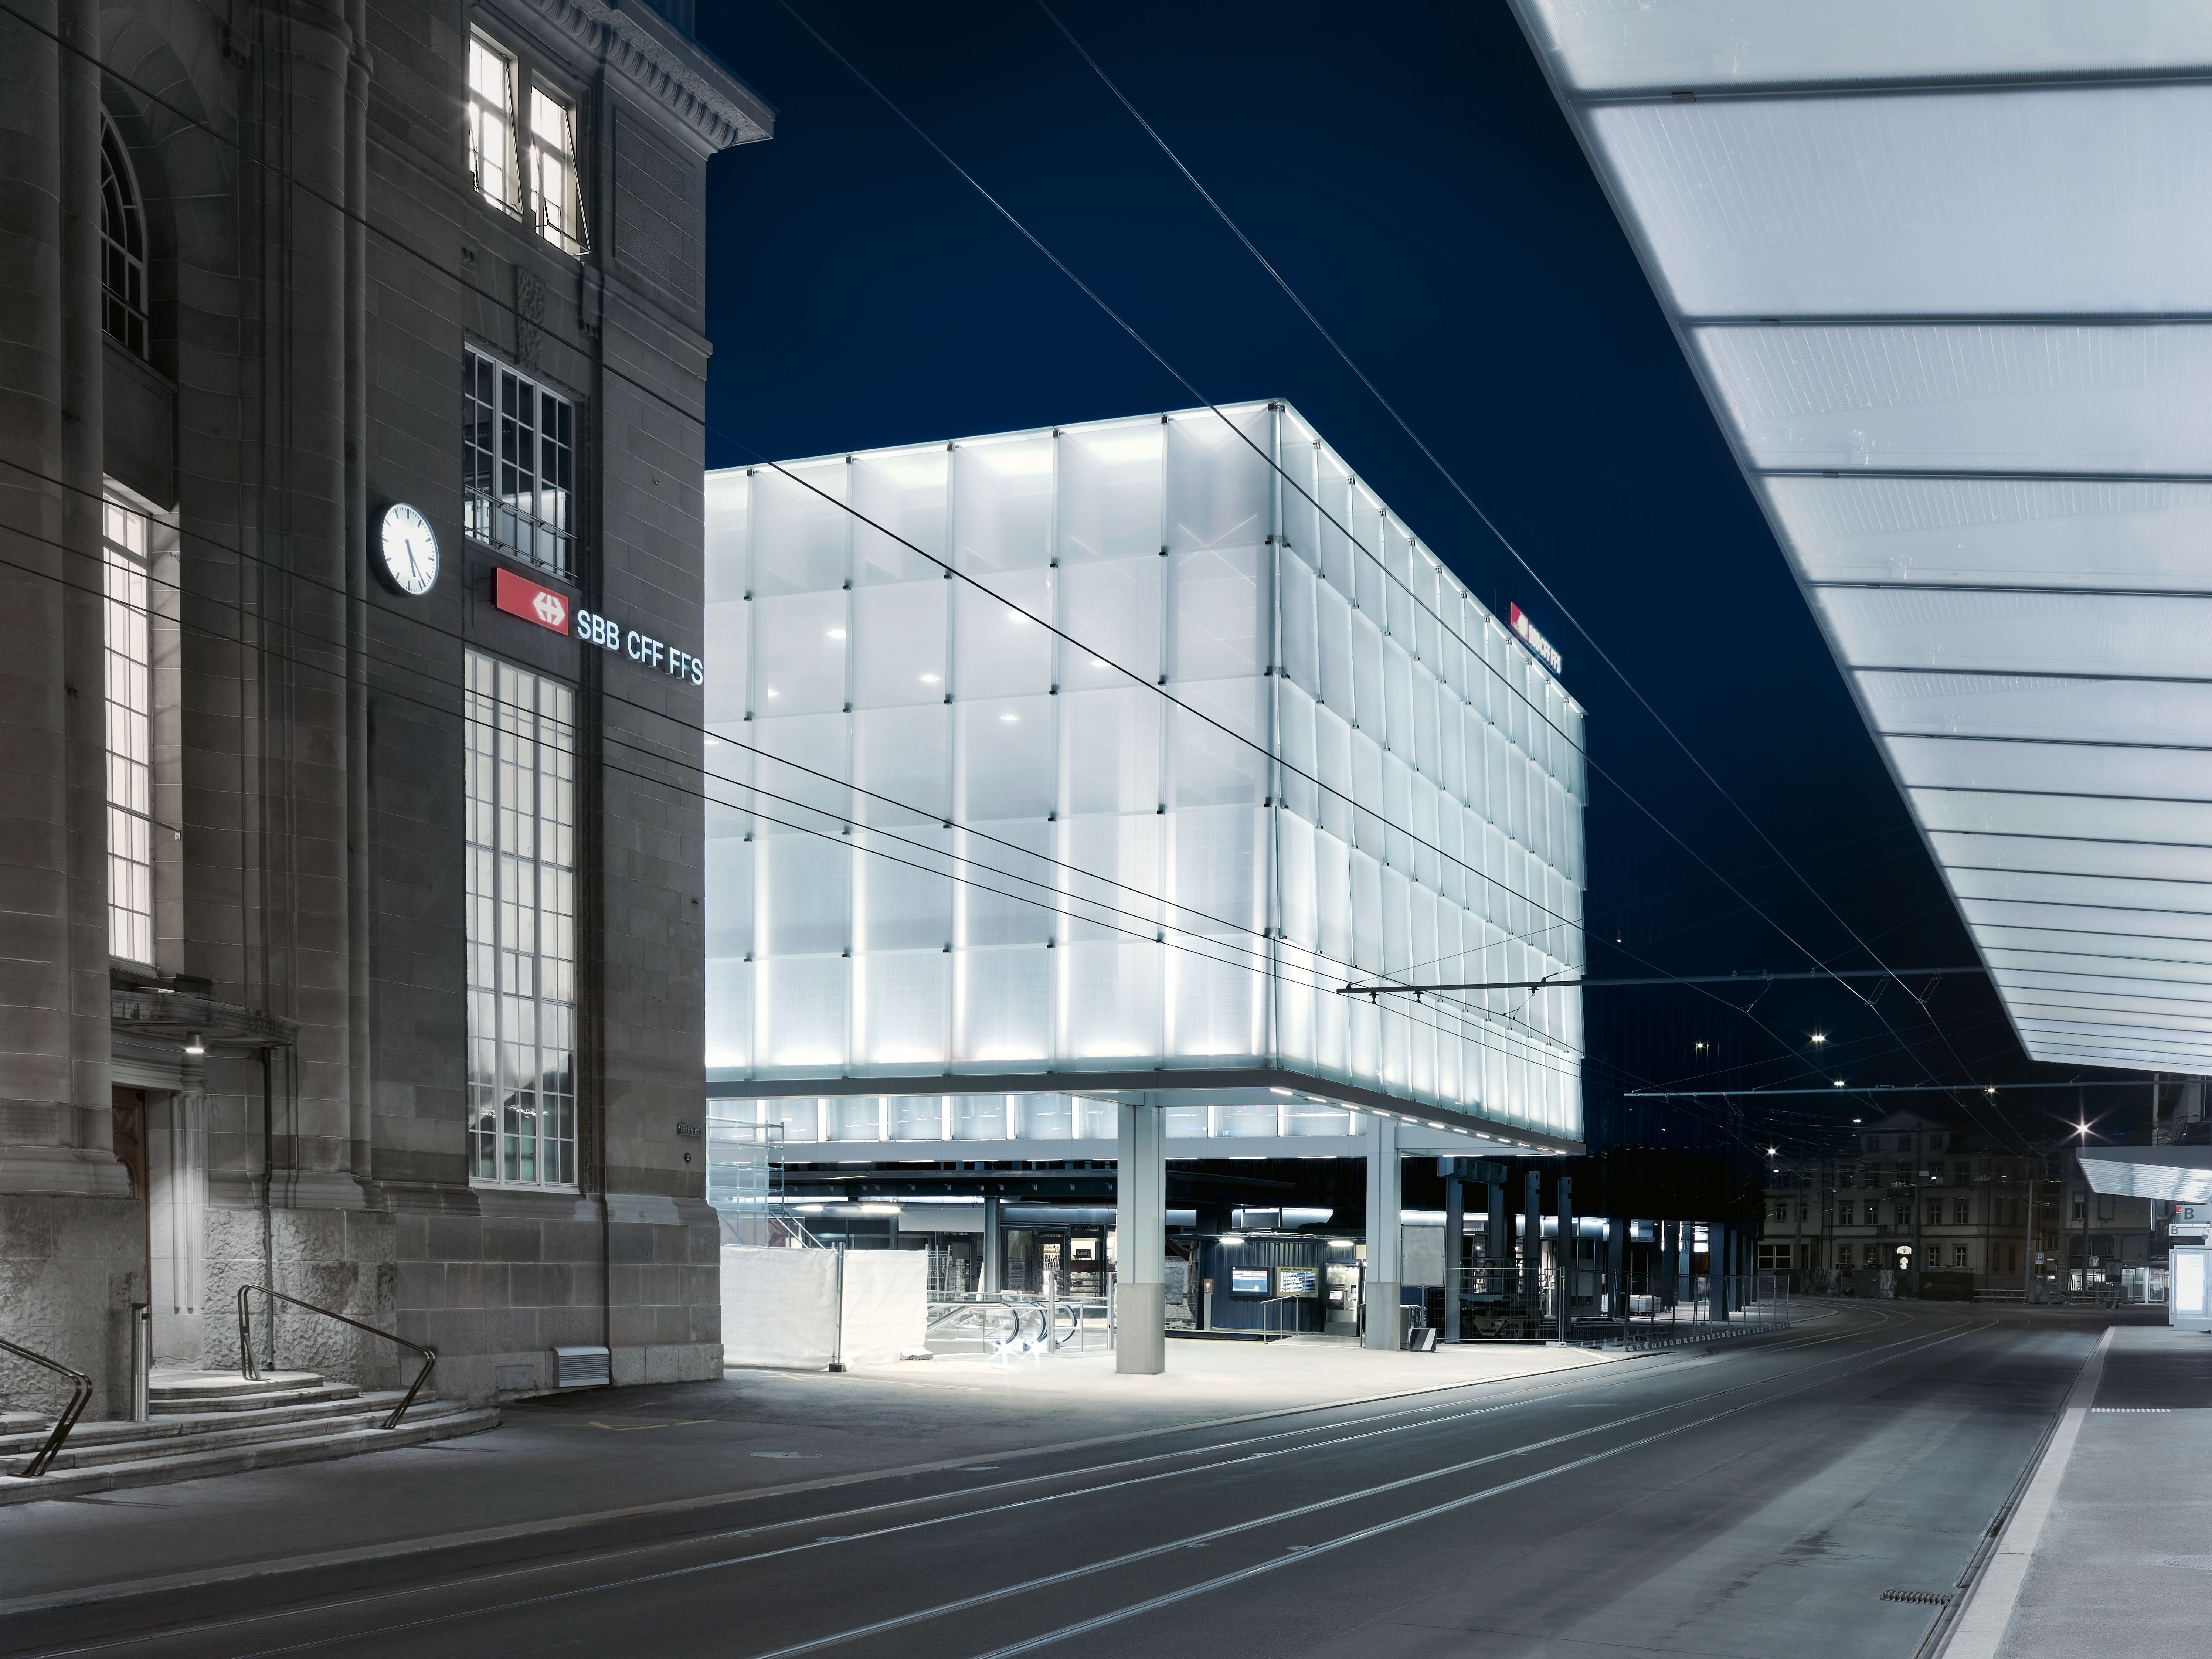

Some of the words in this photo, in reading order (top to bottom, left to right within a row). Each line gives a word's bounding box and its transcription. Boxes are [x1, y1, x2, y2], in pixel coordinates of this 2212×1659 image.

[577, 609, 620, 650] SBB
[627, 630, 663, 667] CFF
[670, 647, 703, 686] FFS
[1540, 638, 1551, 661] CFF
[1551, 648, 1561, 673] FFS
[2184, 1208, 2194, 1220] B
[2171, 1226, 2178, 1234] B
